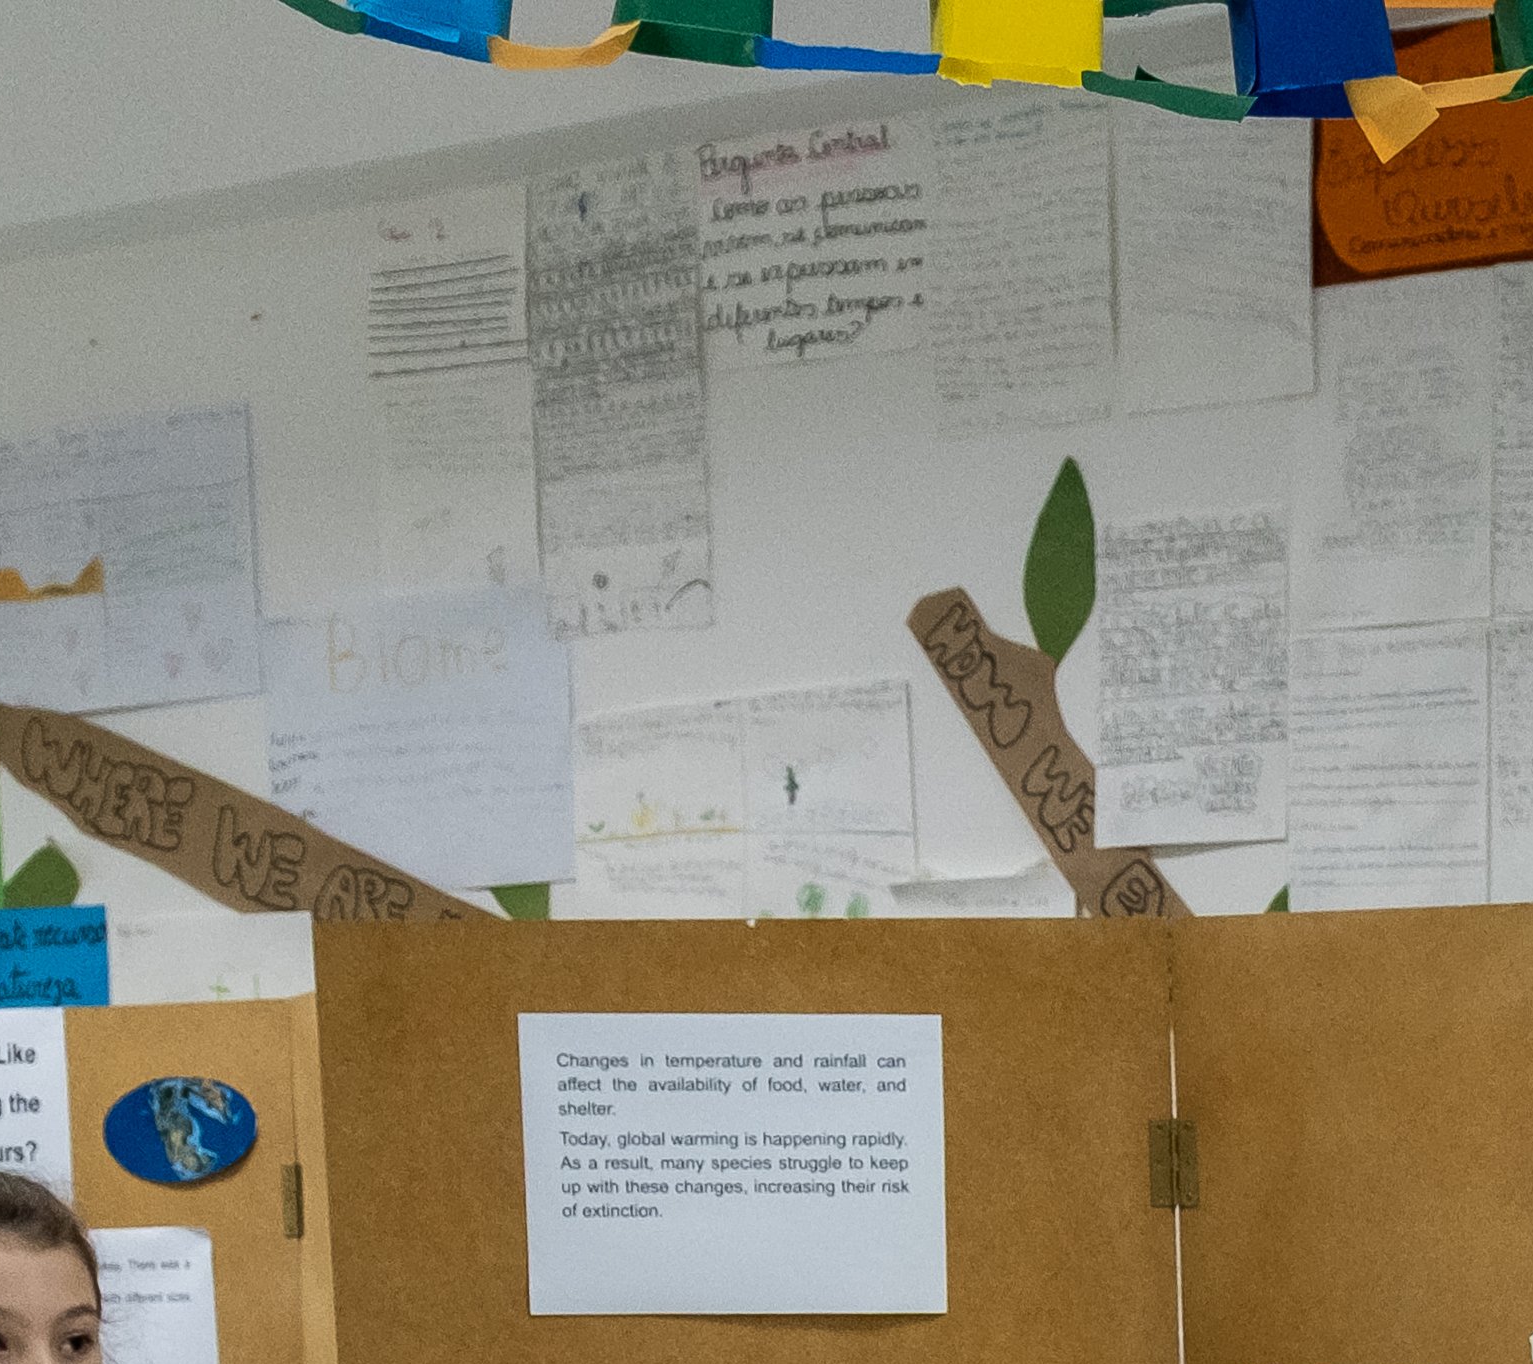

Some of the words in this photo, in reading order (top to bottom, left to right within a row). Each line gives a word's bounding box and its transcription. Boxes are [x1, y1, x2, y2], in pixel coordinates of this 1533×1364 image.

[20, 716, 196, 852] WHERE
[212, 804, 306, 911] WE
[9, 1093, 40, 1113] the
[559, 1130, 611, 1150] Today,
[617, 1132, 666, 1150] global
[671, 1134, 739, 1150] warming
[745, 1135, 758, 1147] is
[763, 1132, 847, 1150] happening
[852, 1132, 907, 1149] rapidly.
